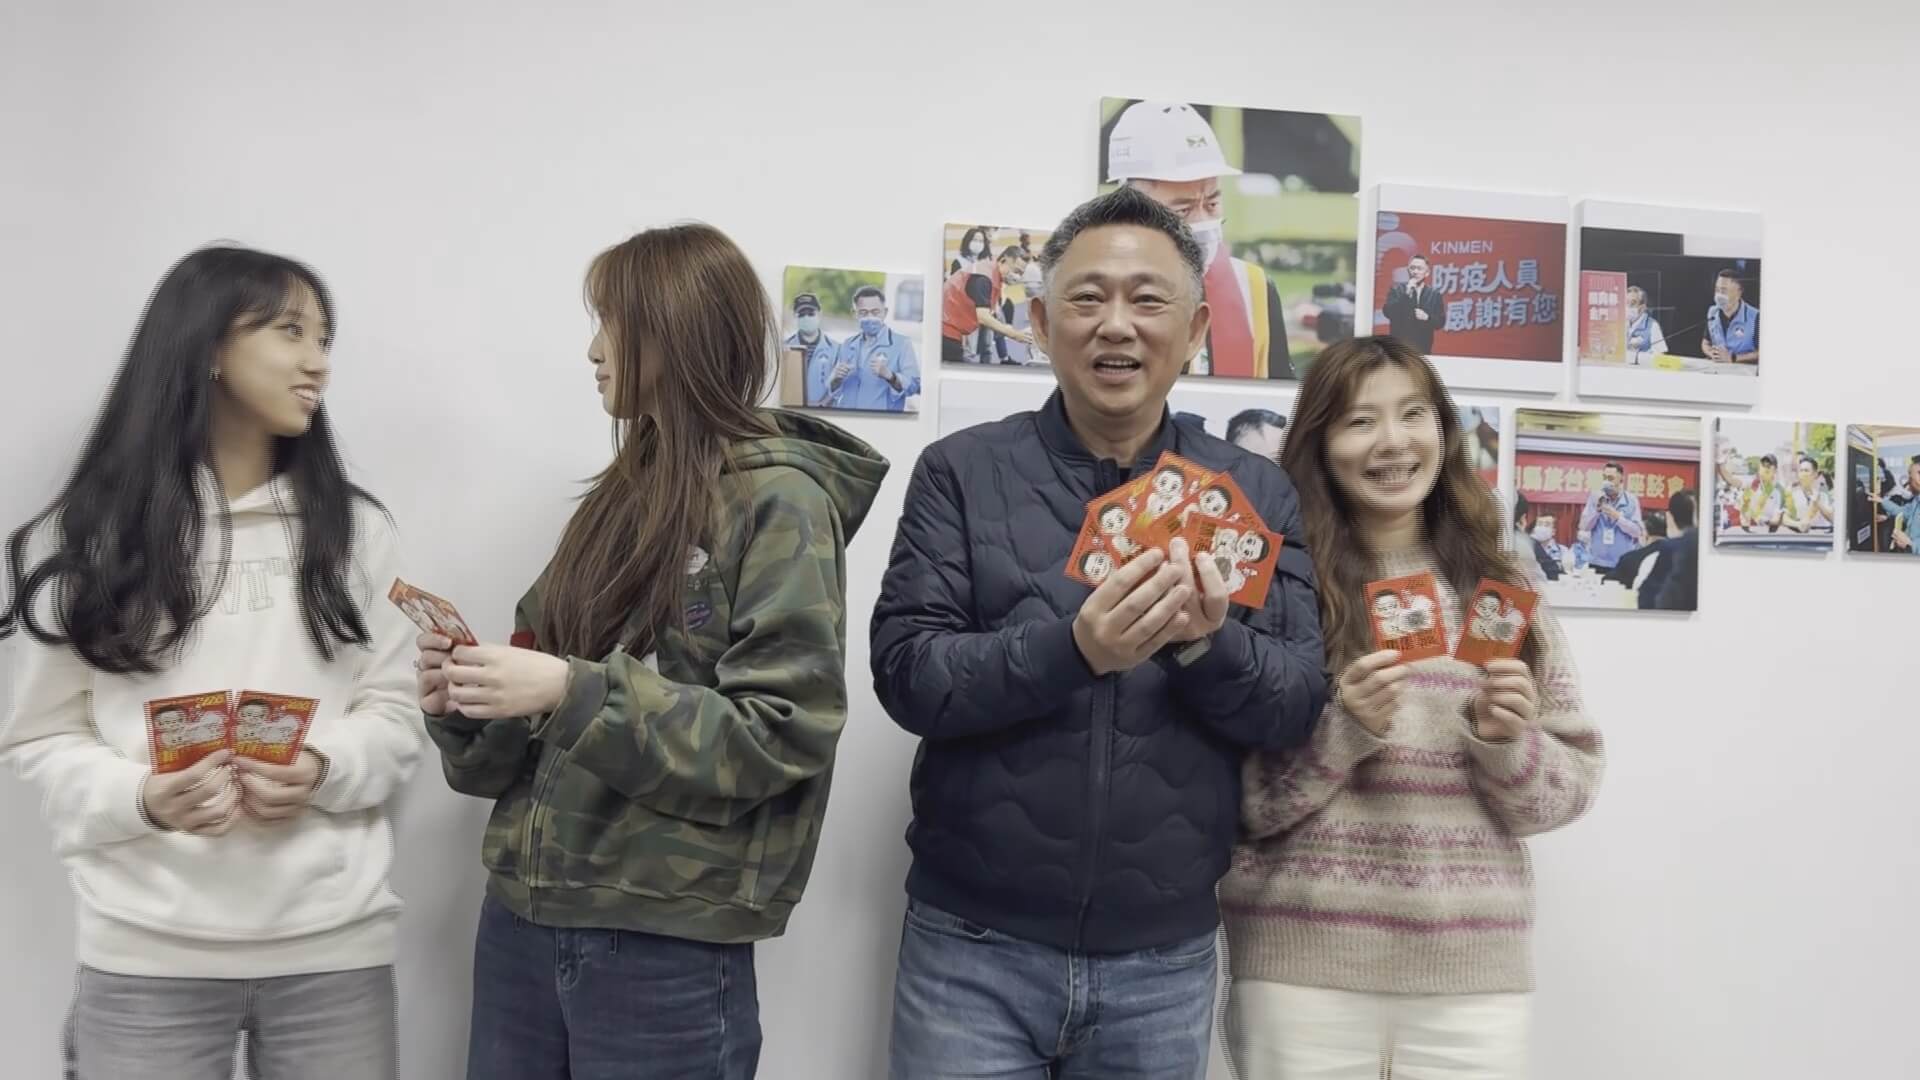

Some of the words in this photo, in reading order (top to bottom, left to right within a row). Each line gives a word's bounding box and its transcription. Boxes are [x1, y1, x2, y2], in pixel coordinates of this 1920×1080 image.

[1431, 240, 1494, 255] KINMEN
[1432, 261, 1541, 295] 防疫人員
[1445, 294, 1556, 331] 感謝有您
